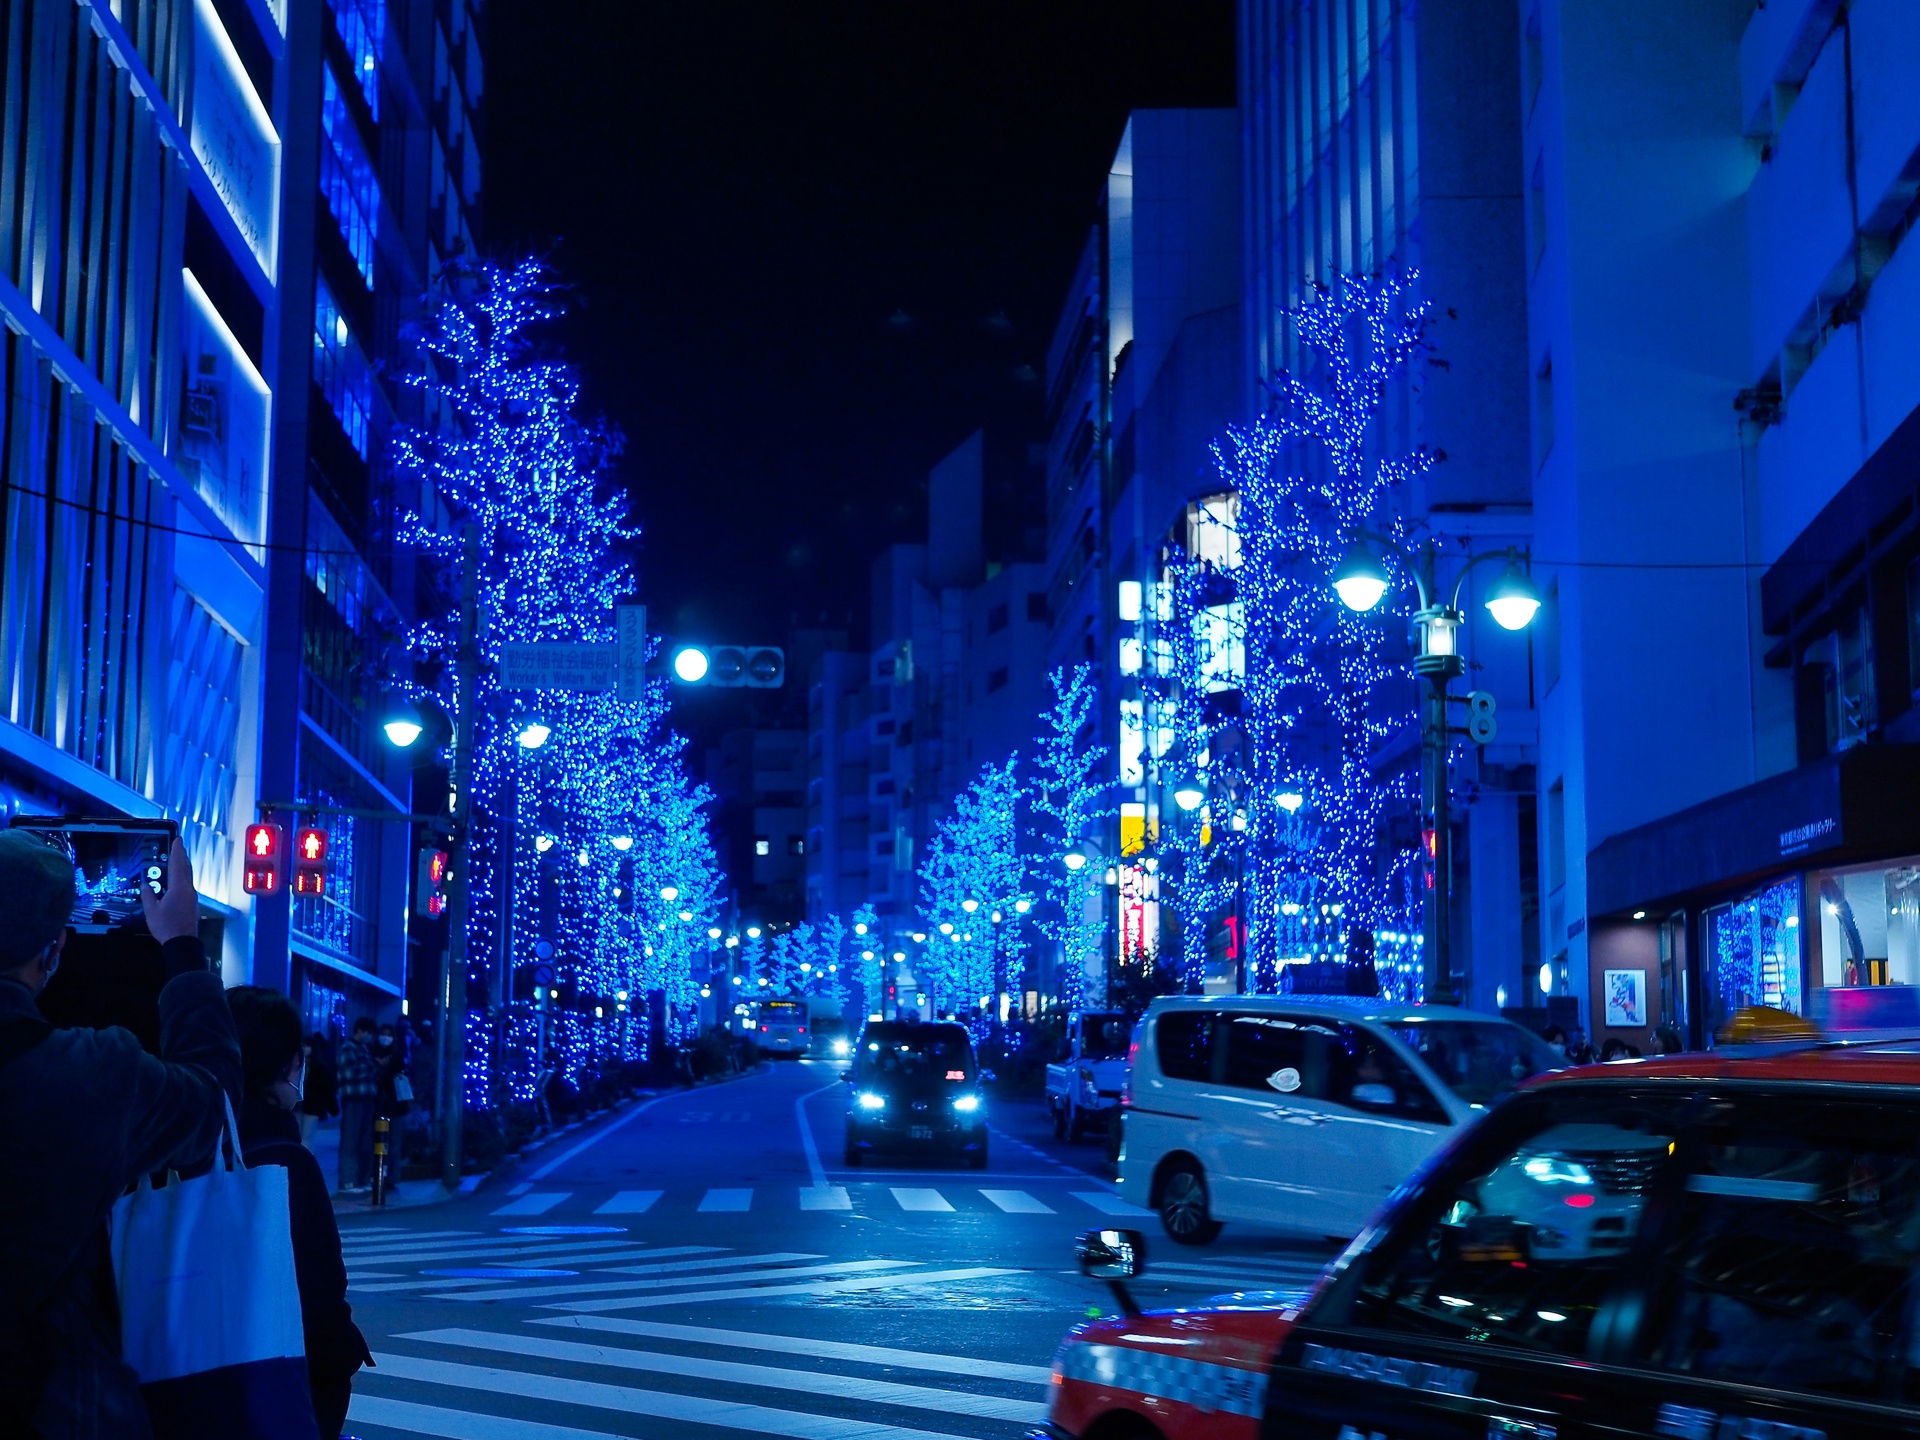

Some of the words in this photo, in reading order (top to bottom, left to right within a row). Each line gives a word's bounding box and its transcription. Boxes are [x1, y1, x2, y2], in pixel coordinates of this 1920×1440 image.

[507, 649, 610, 670] 勤労福祉会館前
[508, 670, 547, 684] Worker's
[552, 671, 585, 685] Welfare
[591, 671, 608, 685] Hall
